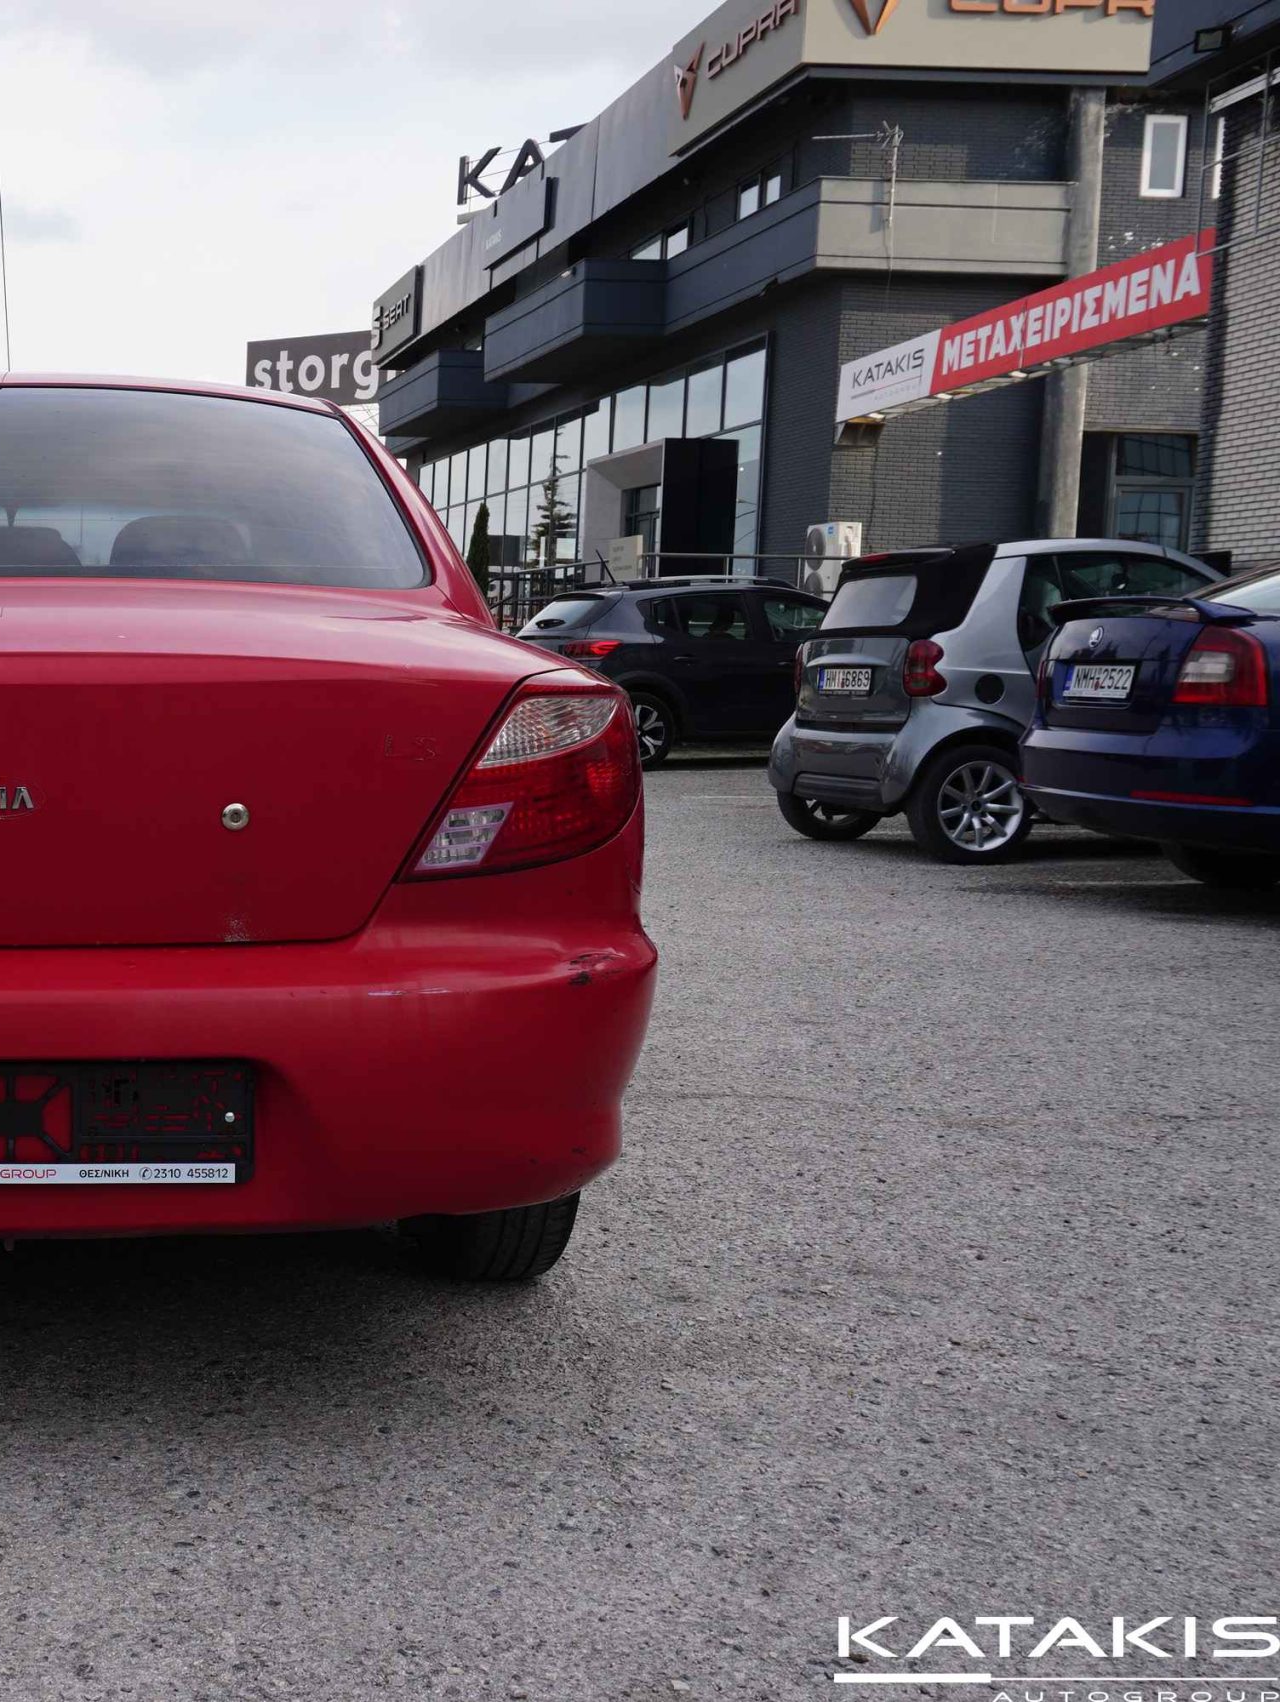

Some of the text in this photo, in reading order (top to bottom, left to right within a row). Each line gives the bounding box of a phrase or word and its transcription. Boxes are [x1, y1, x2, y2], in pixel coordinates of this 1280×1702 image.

[942, 251, 1201, 376] ΜΕΤΑΧΕΙΡΙΣΜΕΝΑ
[254, 350, 396, 400] storg
[852, 348, 925, 390] KATAKIS
[0, 1168, 57, 1179] GROUP
[154, 1168, 229, 1179] 2310 455812
